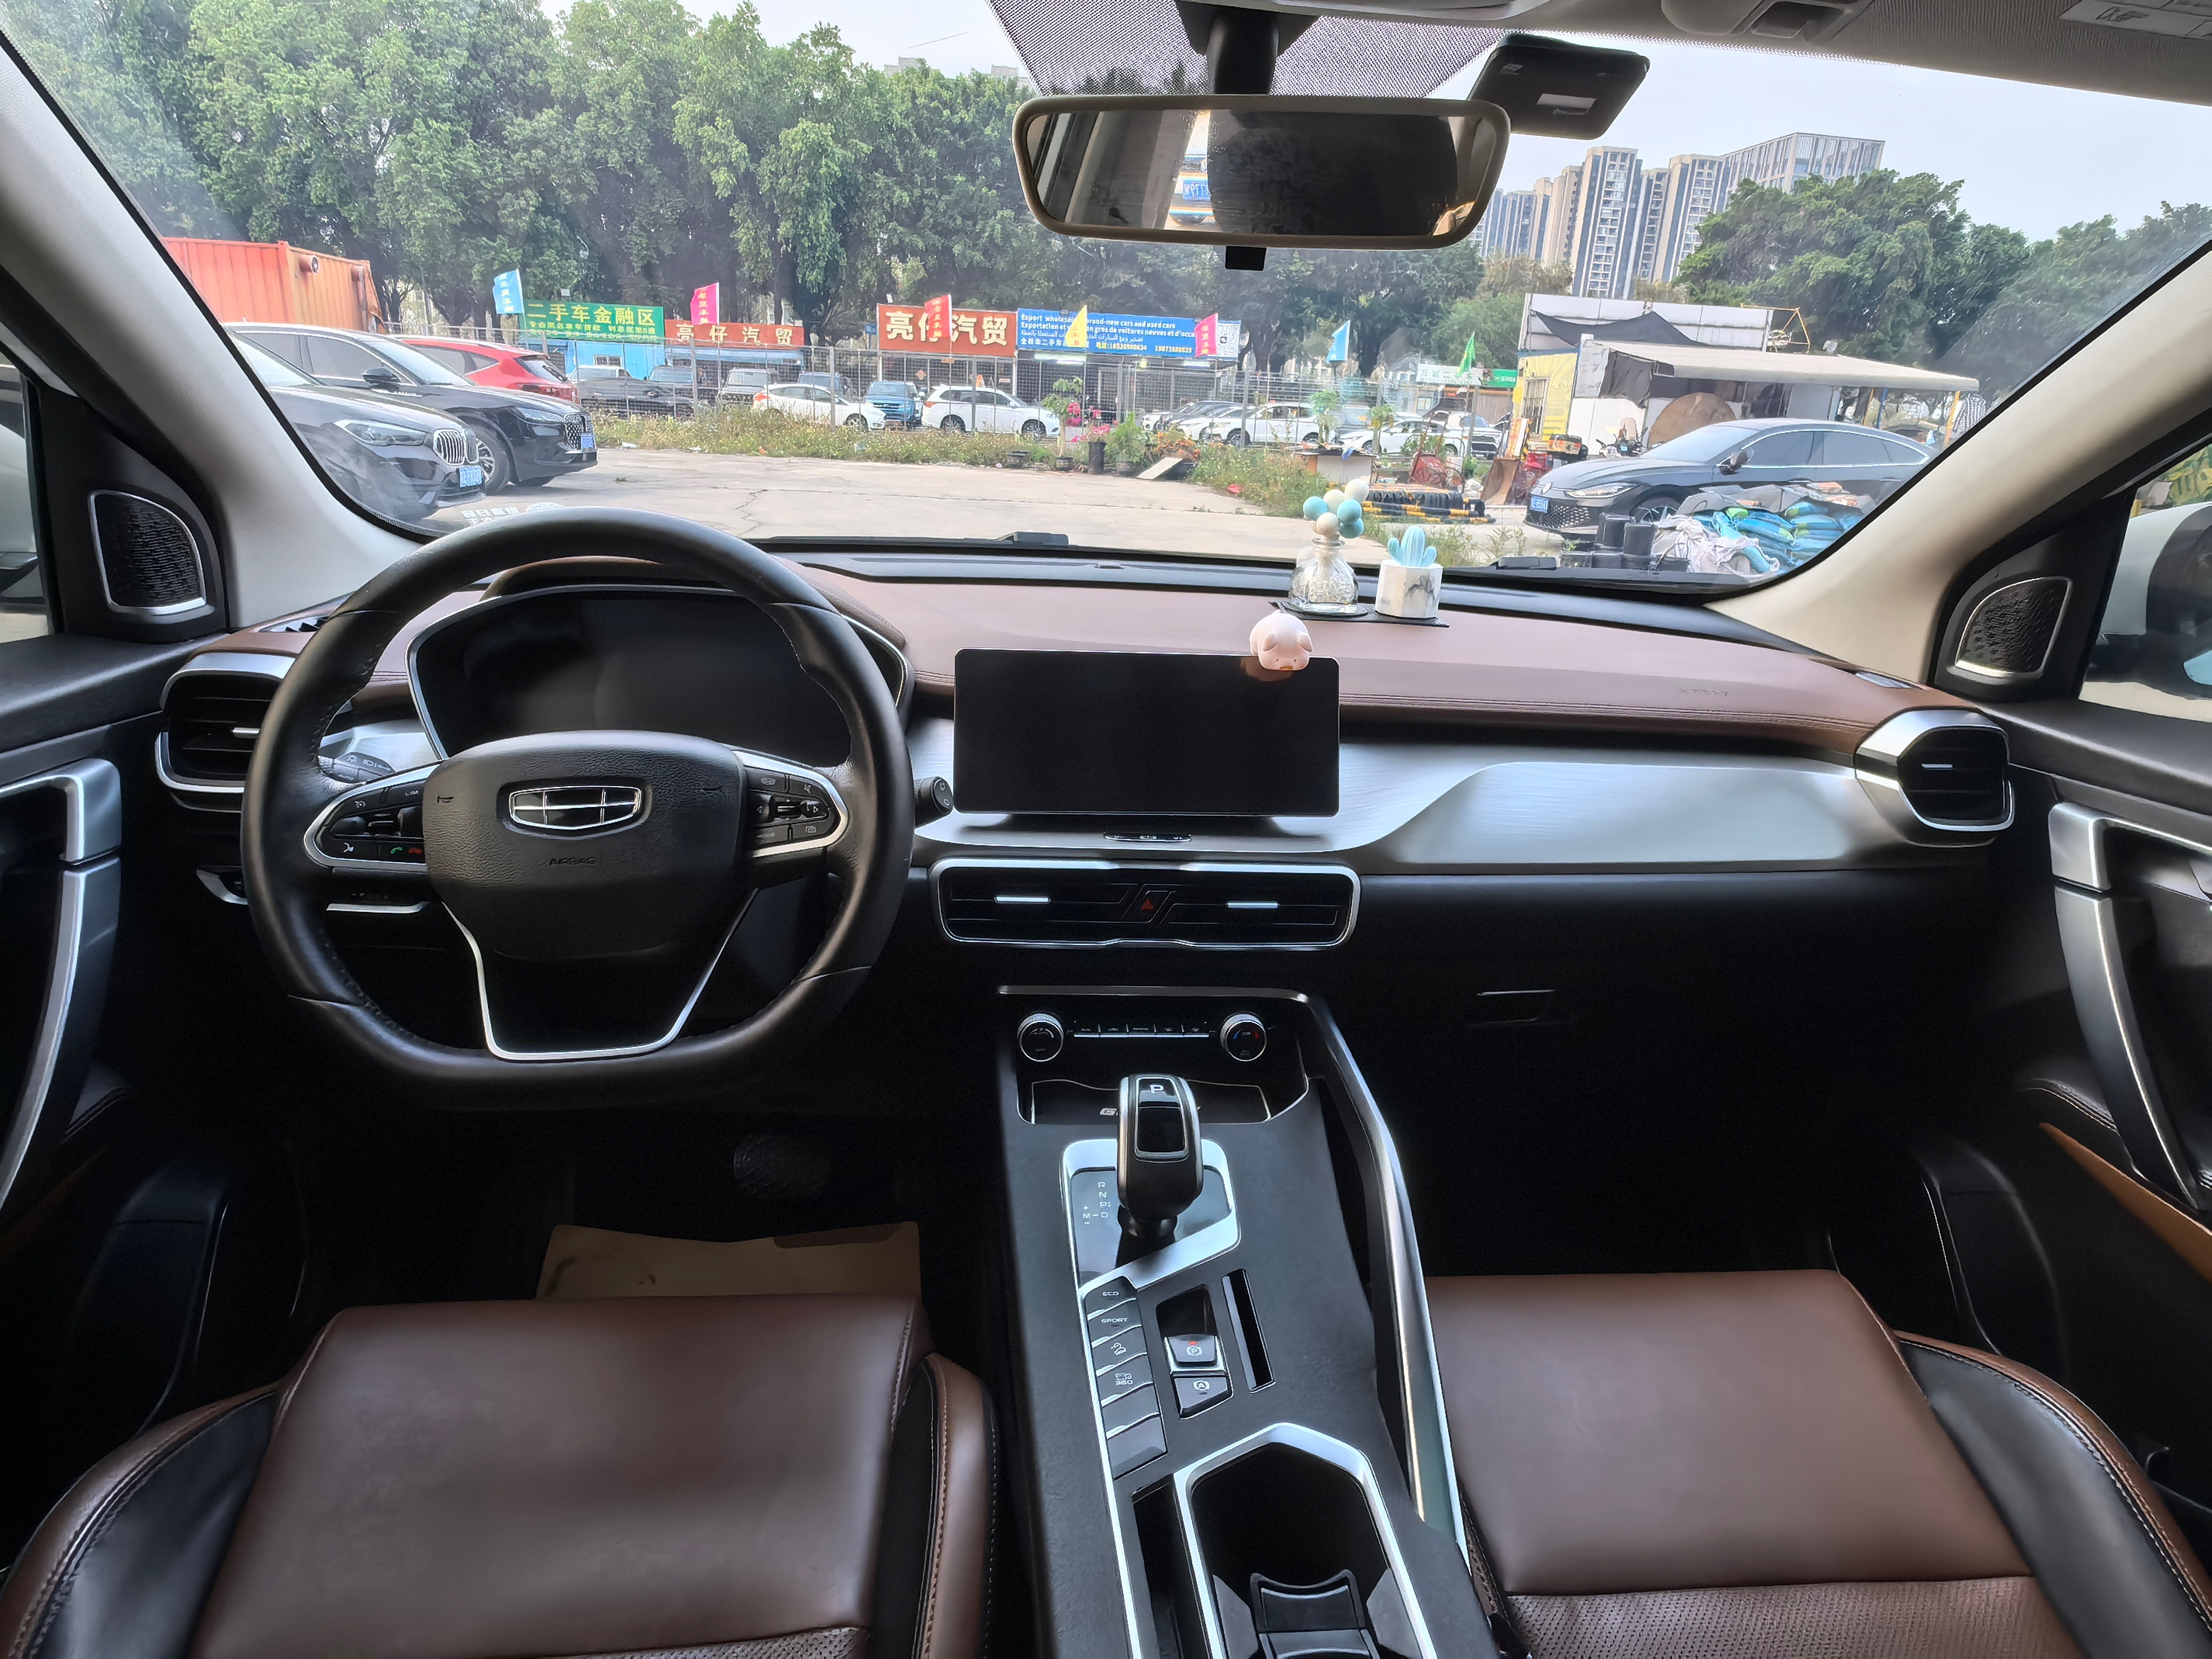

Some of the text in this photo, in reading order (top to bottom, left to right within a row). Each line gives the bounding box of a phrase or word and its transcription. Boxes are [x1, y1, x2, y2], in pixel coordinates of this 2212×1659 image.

[527, 304, 655, 326] 二手车金融区
[1045, 314, 1076, 323] wholesal
[676, 323, 793, 346] 亮仔汽贸
[1150, 1085, 1164, 1094] P
